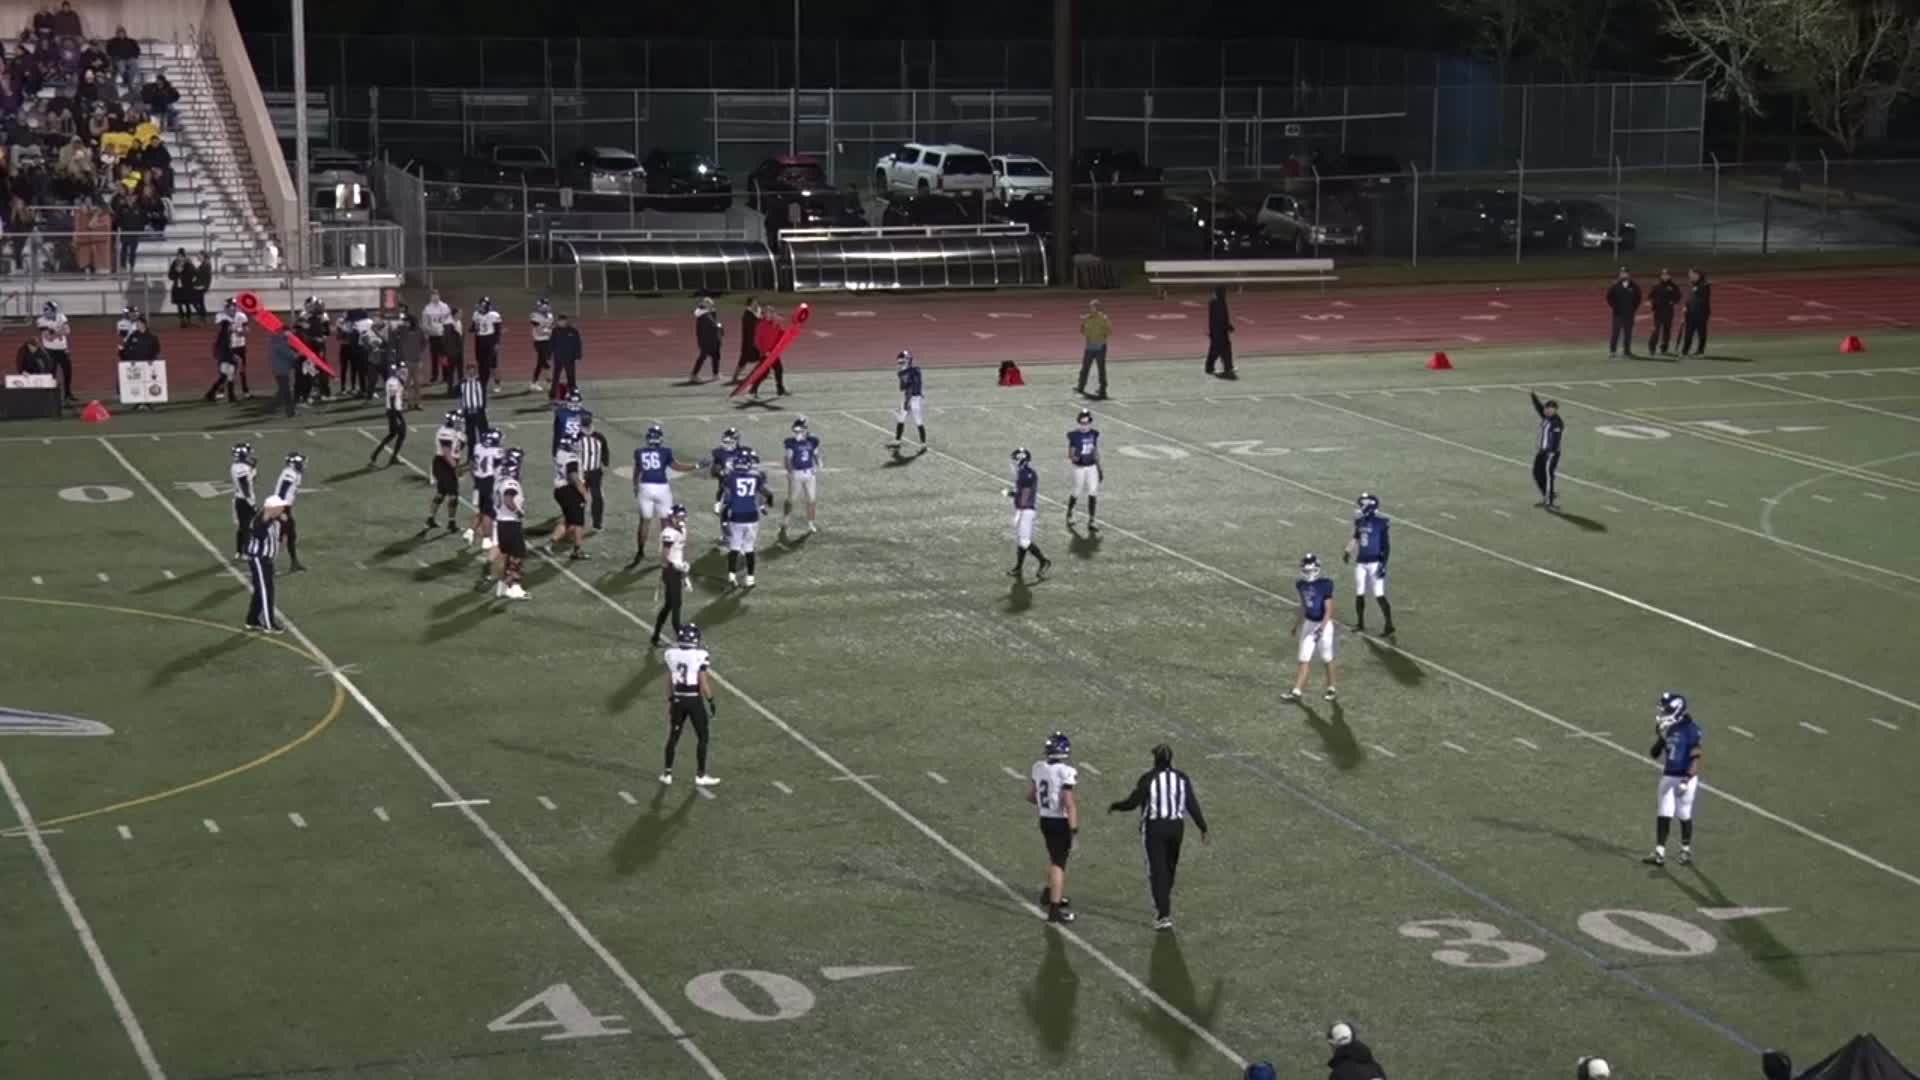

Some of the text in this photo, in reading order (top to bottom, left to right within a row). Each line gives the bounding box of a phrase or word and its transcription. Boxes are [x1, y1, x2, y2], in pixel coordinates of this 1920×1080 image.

[640, 452, 662, 471] 56
[735, 477, 757, 497] 57
[1038, 778, 1050, 809] 2
[1398, 908, 1719, 969] 30
[486, 966, 817, 1042] 40
